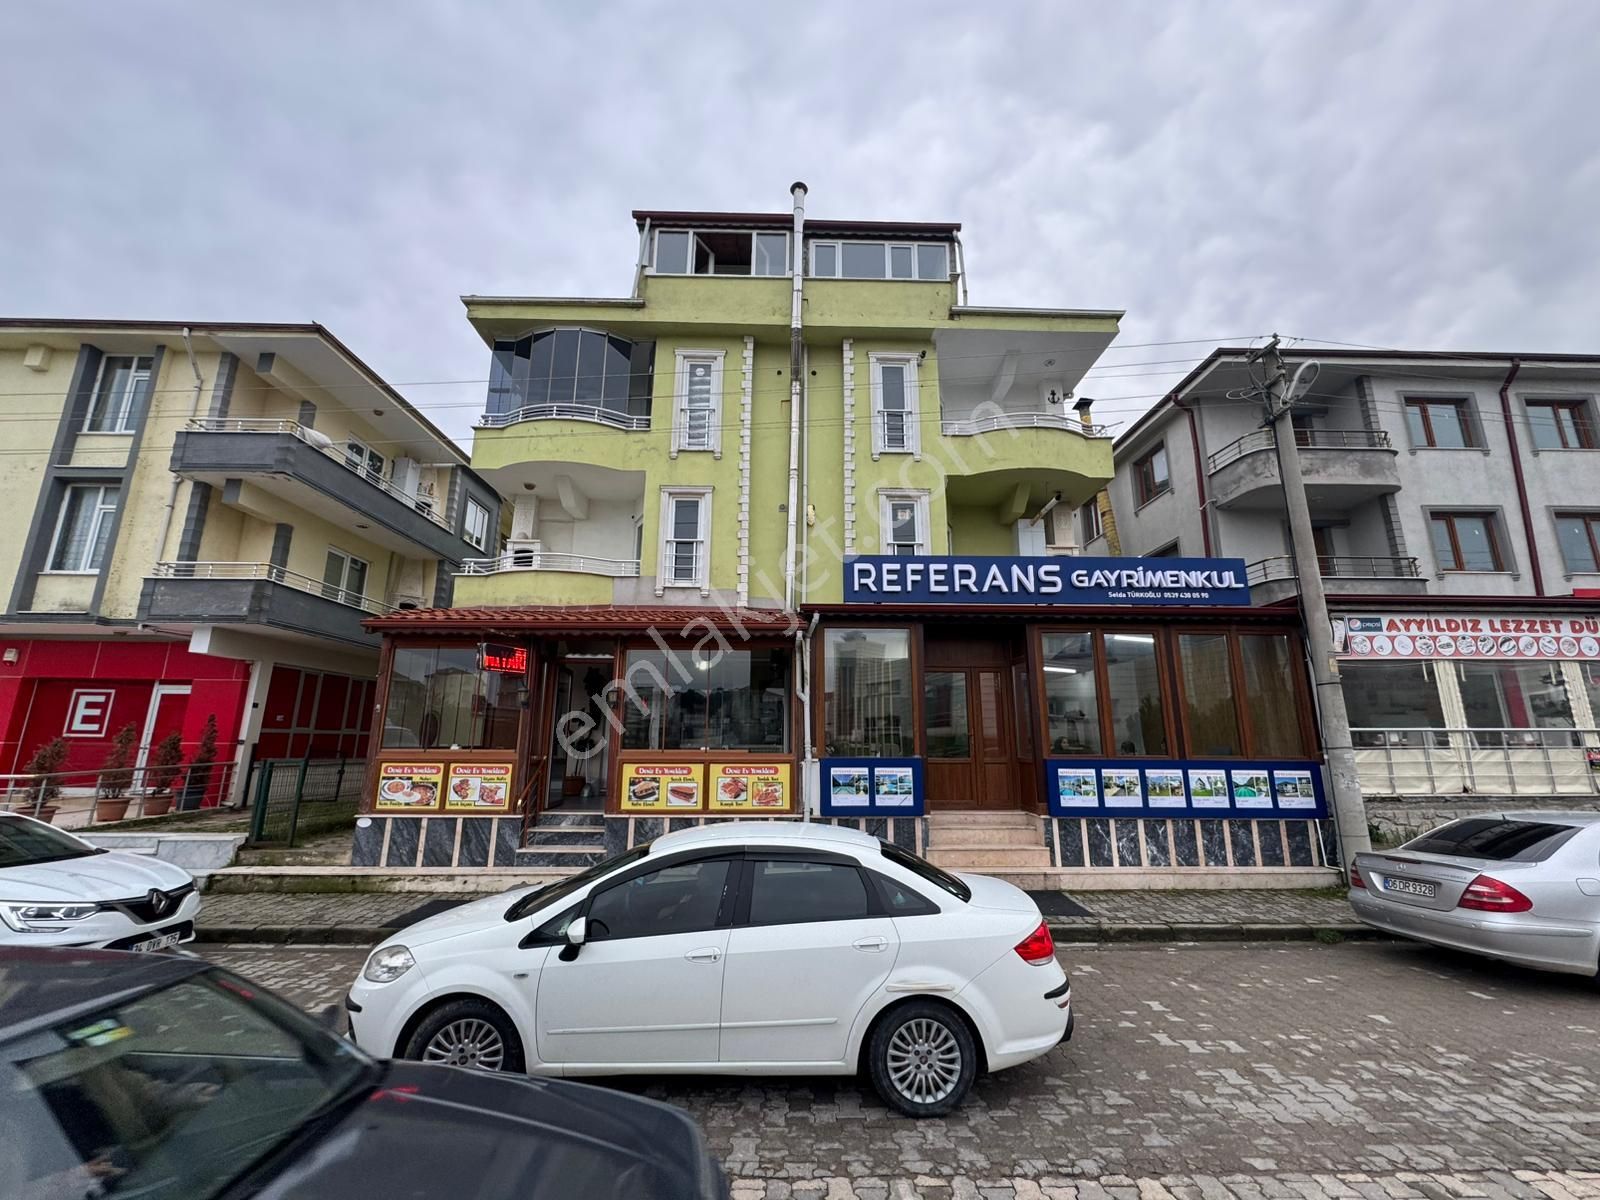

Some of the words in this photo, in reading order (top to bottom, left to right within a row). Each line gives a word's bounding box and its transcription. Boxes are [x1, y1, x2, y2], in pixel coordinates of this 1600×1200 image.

[853, 563, 1063, 593] REFERANS
[1071, 566, 1245, 588] GAYRİMENKUL
[1386, 618, 1483, 633] AYYILDIZ
[1489, 618, 1563, 634] LEZZET
[1569, 615, 1600, 635] DÜ
[71, 695, 107, 731] E
[1388, 879, 1398, 889] 06
[1399, 880, 1411, 891] DR
[1412, 882, 1434, 896] 9328
